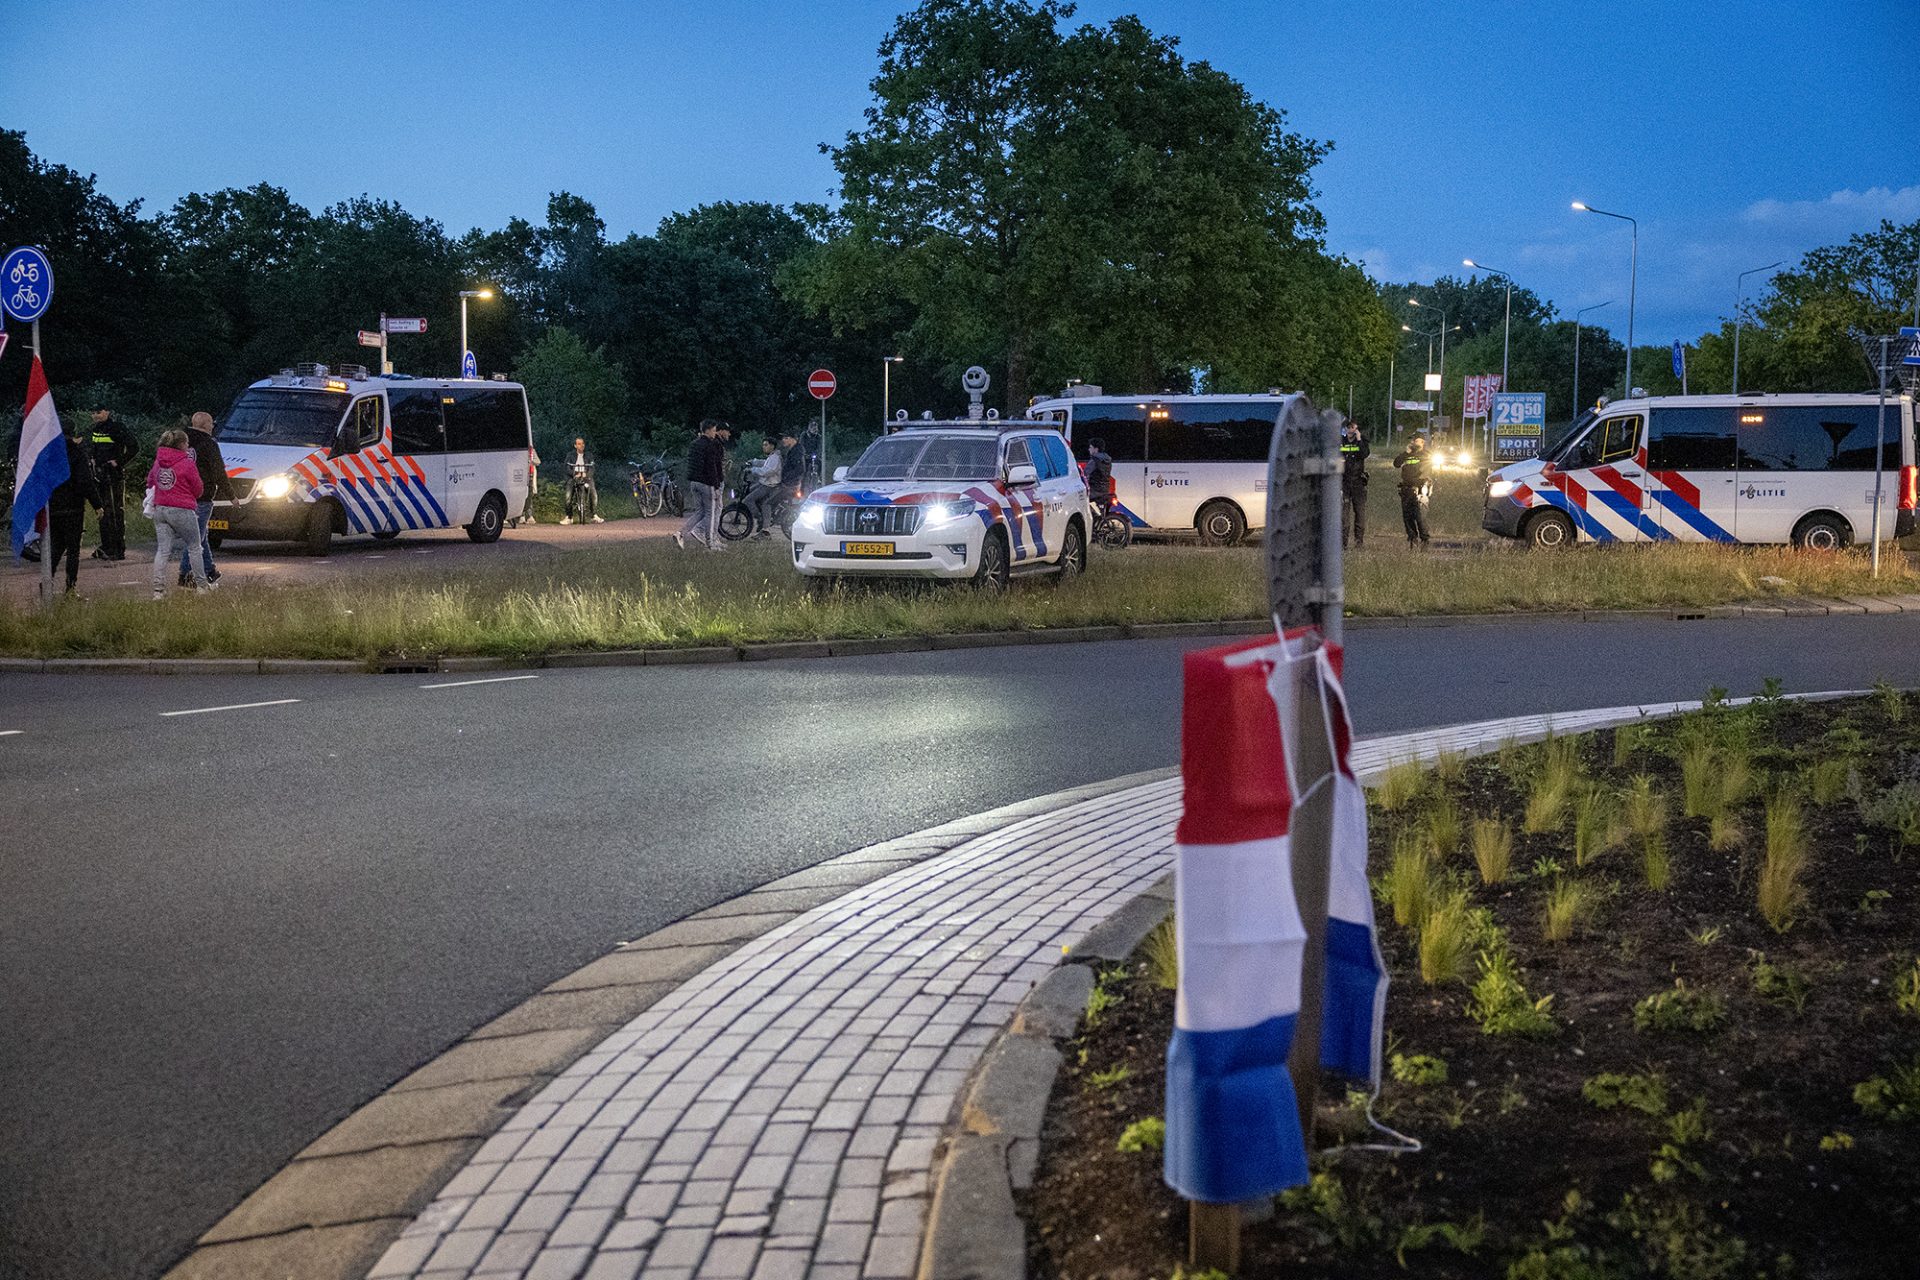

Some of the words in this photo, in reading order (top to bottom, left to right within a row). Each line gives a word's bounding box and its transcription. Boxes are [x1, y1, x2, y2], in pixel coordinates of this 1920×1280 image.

[1467, 378, 1476, 412] LIVE
[1500, 439, 1537, 448] SPORT
[1497, 449, 1538, 457] FABRIEK
[1151, 477, 1189, 488] POLITIE
[1739, 488, 1786, 499] POLITIE
